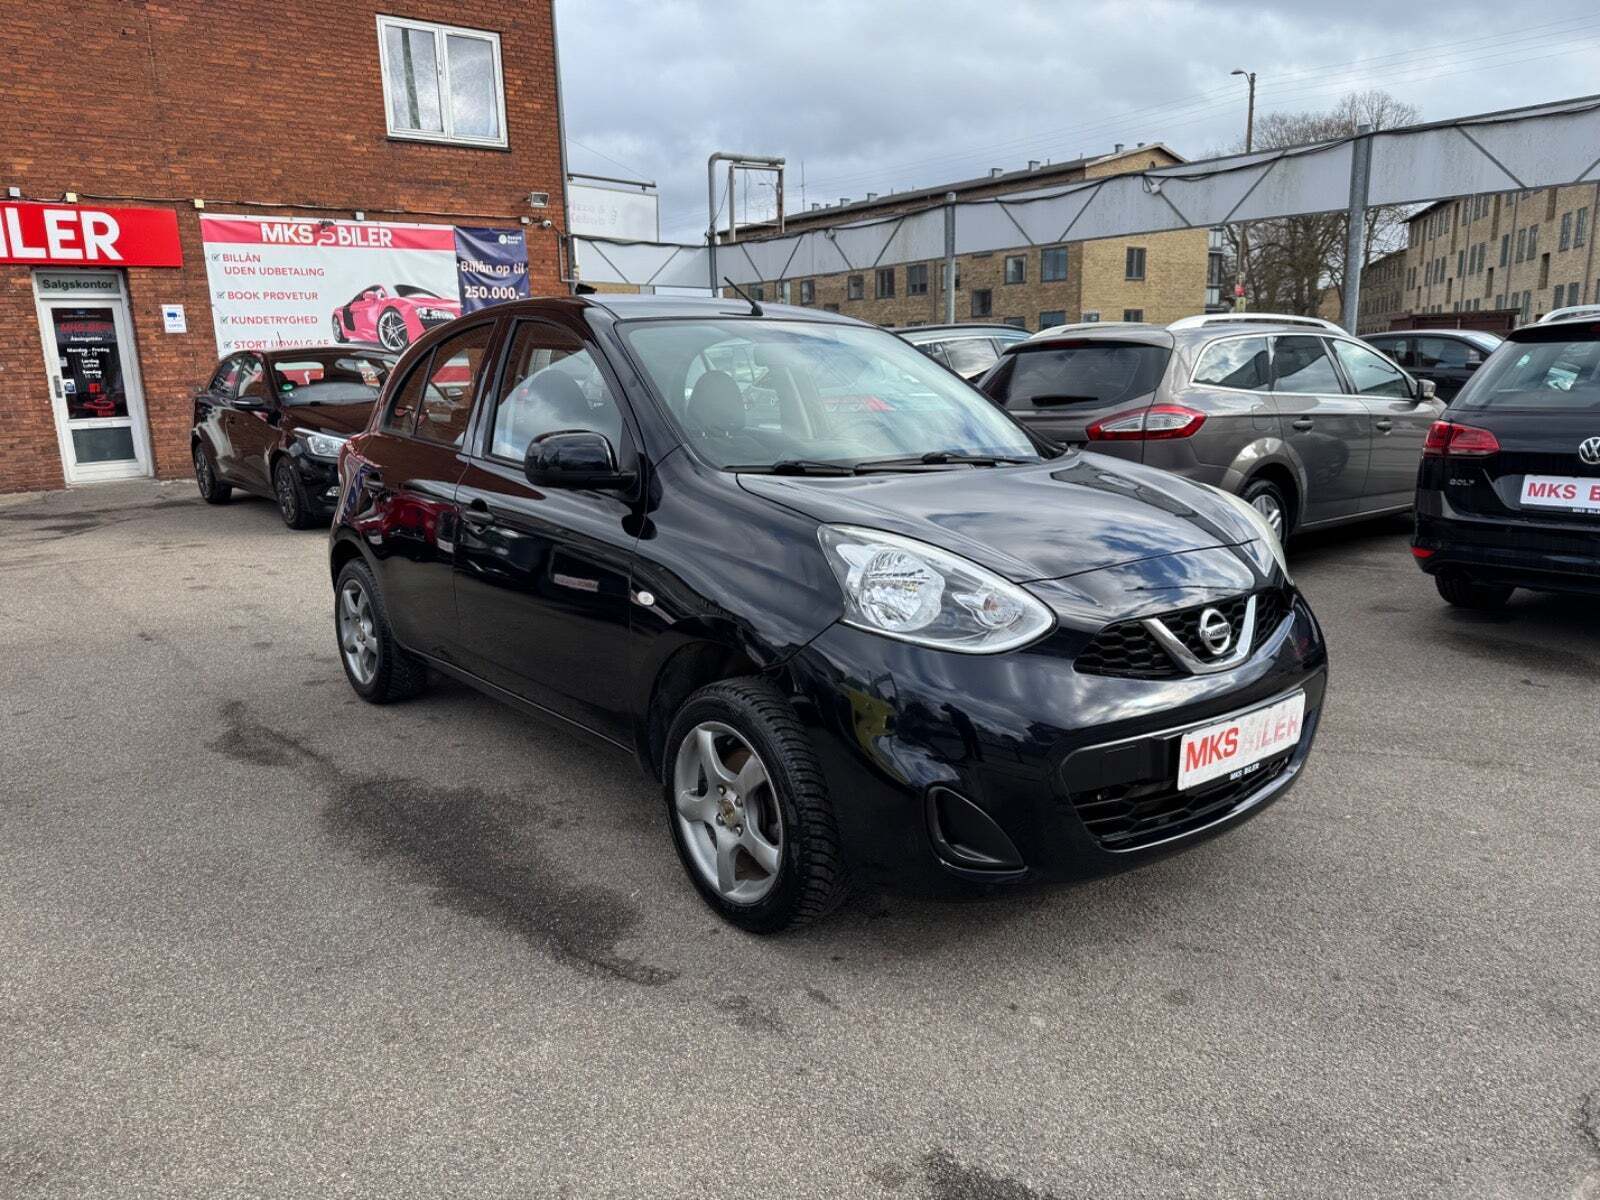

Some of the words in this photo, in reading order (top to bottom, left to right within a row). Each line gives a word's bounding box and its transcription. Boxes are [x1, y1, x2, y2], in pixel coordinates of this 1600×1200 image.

[260, 223, 314, 244] MKS
[337, 226, 393, 247] BILER
[222, 252, 261, 263] BILLÅN
[224, 266, 256, 276] UDEN
[259, 267, 325, 277] UDBETALING
[496, 265, 510, 276] op
[513, 262, 525, 274] til
[42, 279, 114, 291] Salgskontor
[227, 291, 259, 301] BOOK
[263, 291, 318, 301] PRØVETUR
[231, 316, 318, 325] KUNDETRYGHED
[234, 341, 267, 350] STORT
[1526, 482, 1577, 500] MKS
[1185, 727, 1239, 772] MKS
